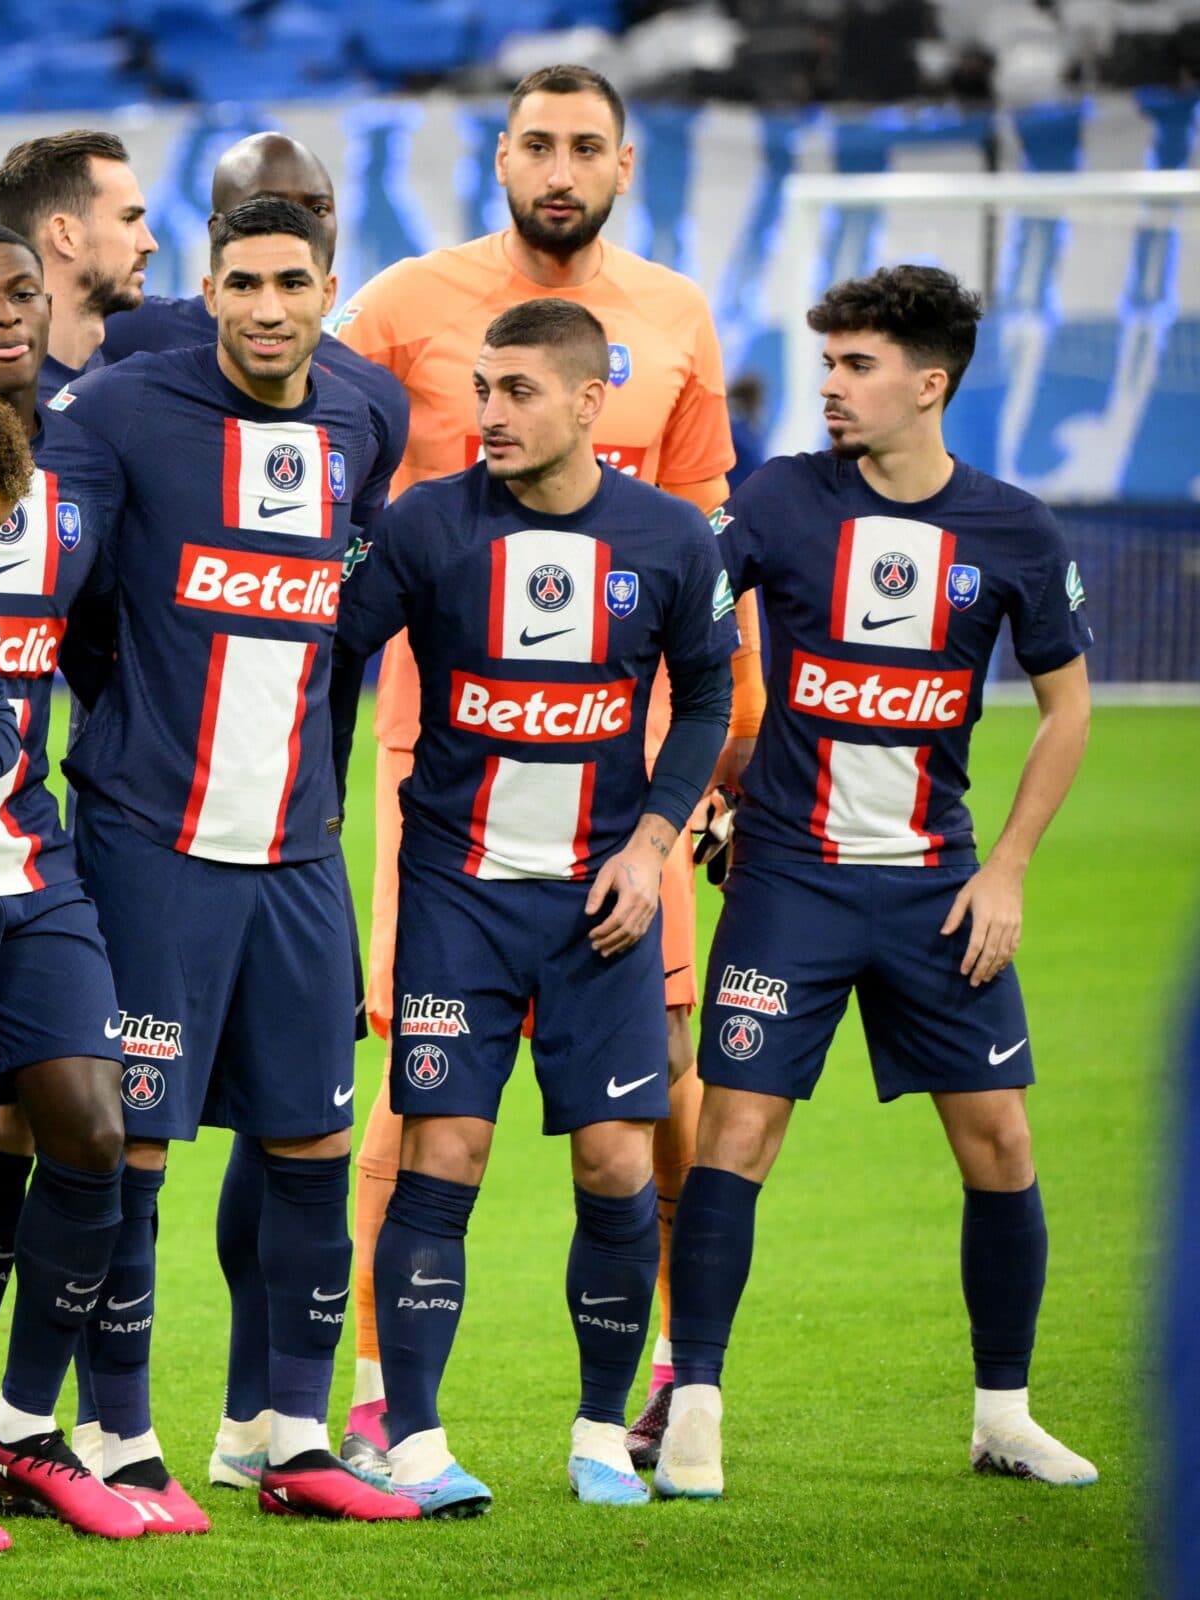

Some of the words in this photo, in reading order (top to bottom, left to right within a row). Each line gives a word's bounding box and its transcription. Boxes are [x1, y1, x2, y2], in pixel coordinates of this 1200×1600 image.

[273, 448, 298, 460] PARIS
[880, 555, 910, 568] PARIS
[535, 568, 565, 579] PARIS
[184, 556, 338, 616] Betclic
[795, 663, 964, 722] Betclic
[457, 681, 626, 736] Betclic
[729, 1018, 757, 1030] PARIS
[413, 1046, 440, 1057] PARIS
[130, 1066, 159, 1079] PARIS
[397, 1297, 459, 1311] PARIS
[100, 1314, 152, 1333] PARIS
[309, 1310, 344, 1324] PAR
[579, 1314, 640, 1333] PARIS
